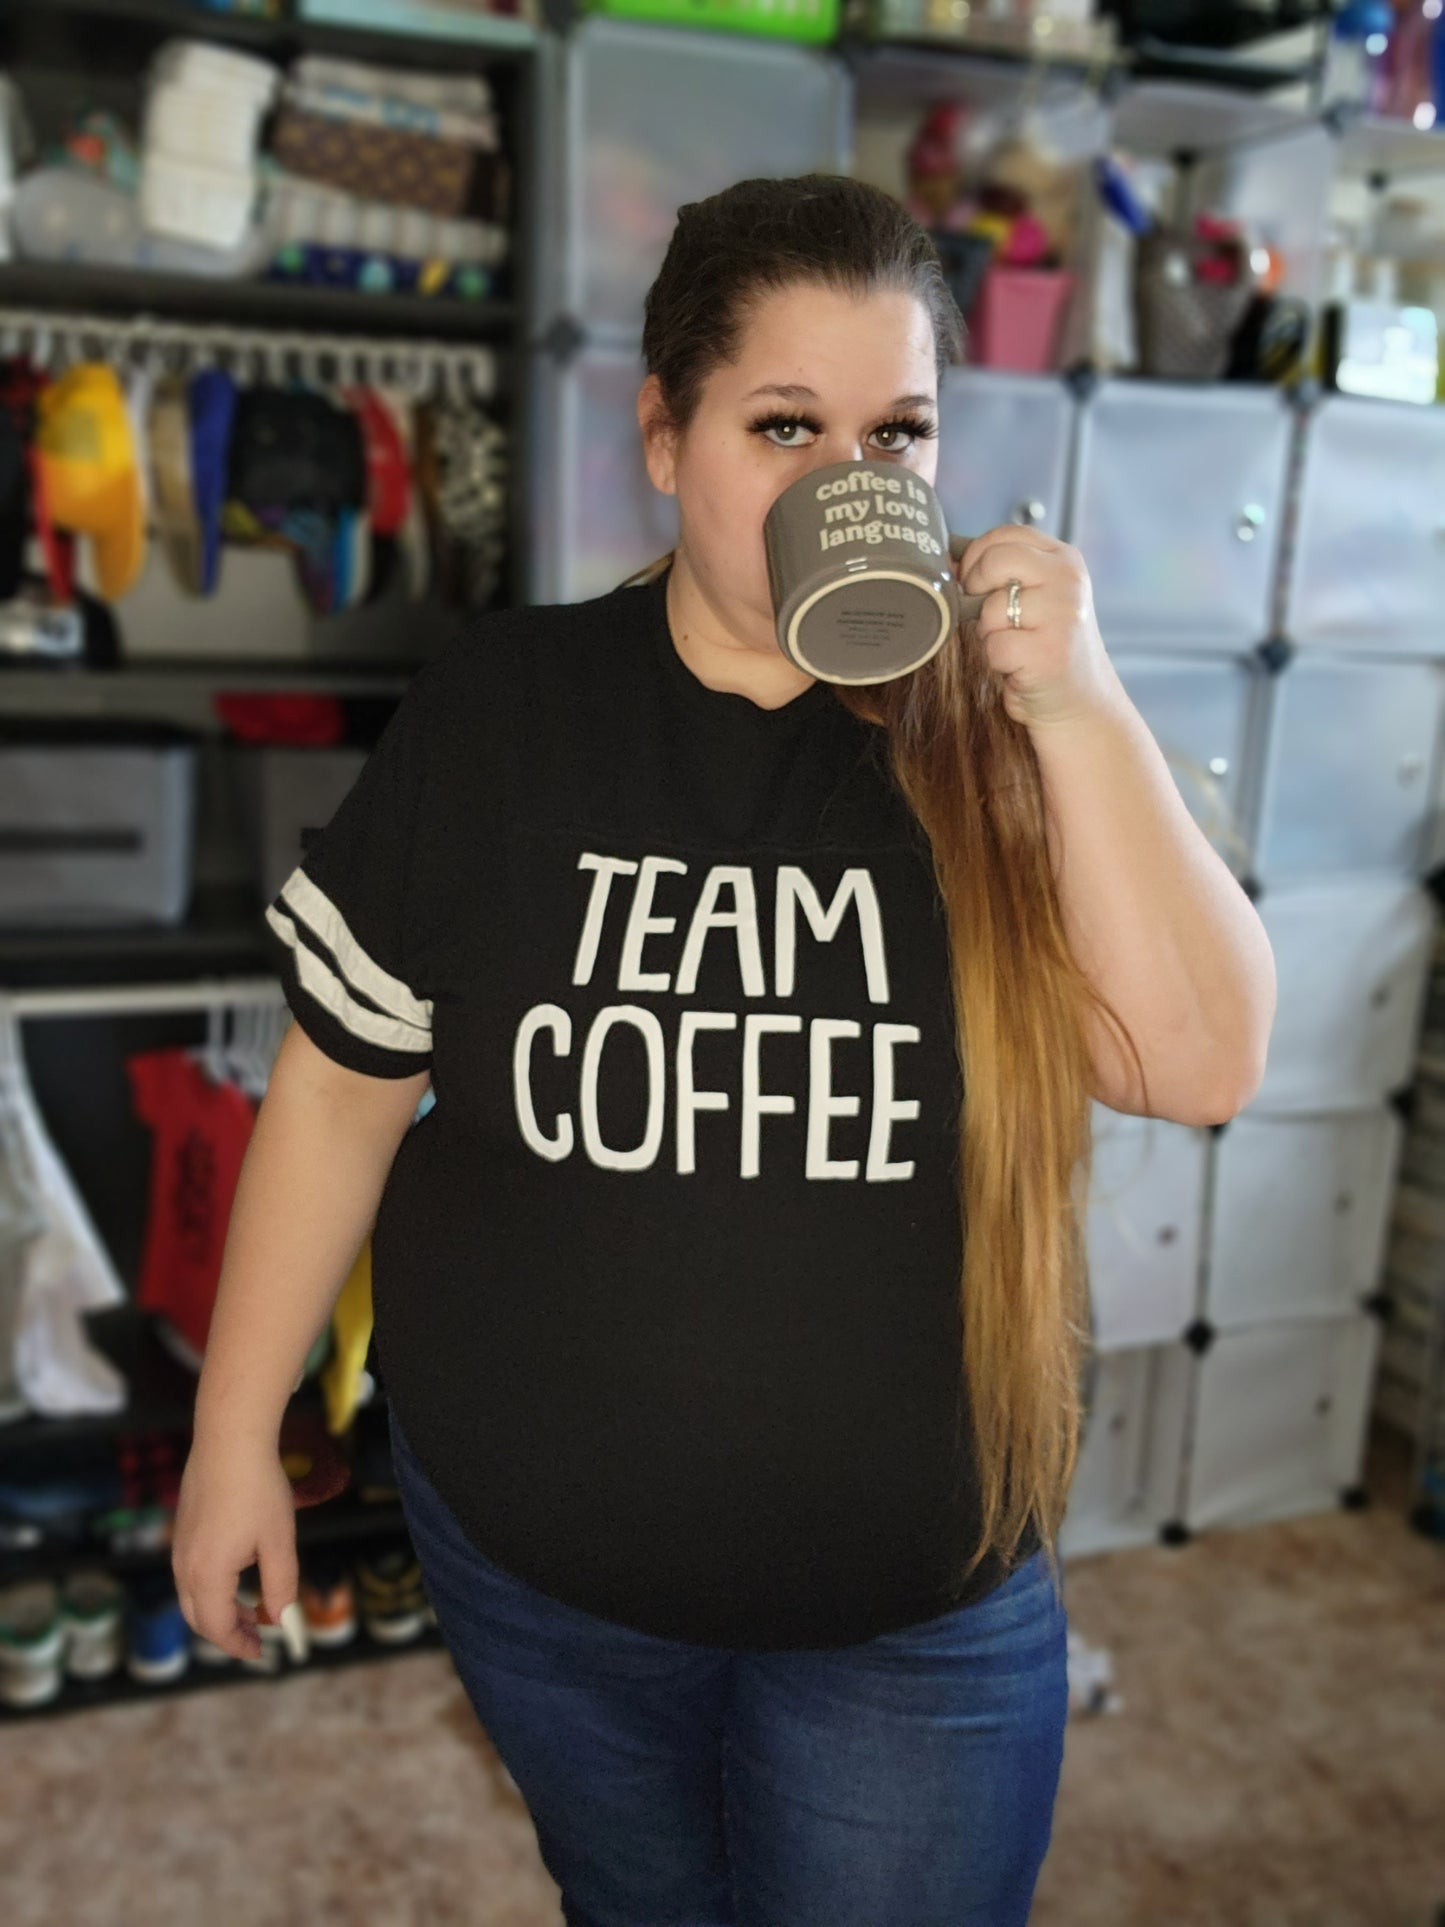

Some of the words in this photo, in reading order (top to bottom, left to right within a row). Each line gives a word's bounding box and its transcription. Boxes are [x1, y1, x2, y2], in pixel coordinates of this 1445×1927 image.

[816, 470, 902, 501] coffee
[906, 479, 927, 505] is
[824, 500, 870, 523] my
[875, 494, 929, 526] love
[820, 520, 941, 556] language
[573, 852, 889, 1004] TEAM
[513, 1003, 920, 1182] COFFEE
